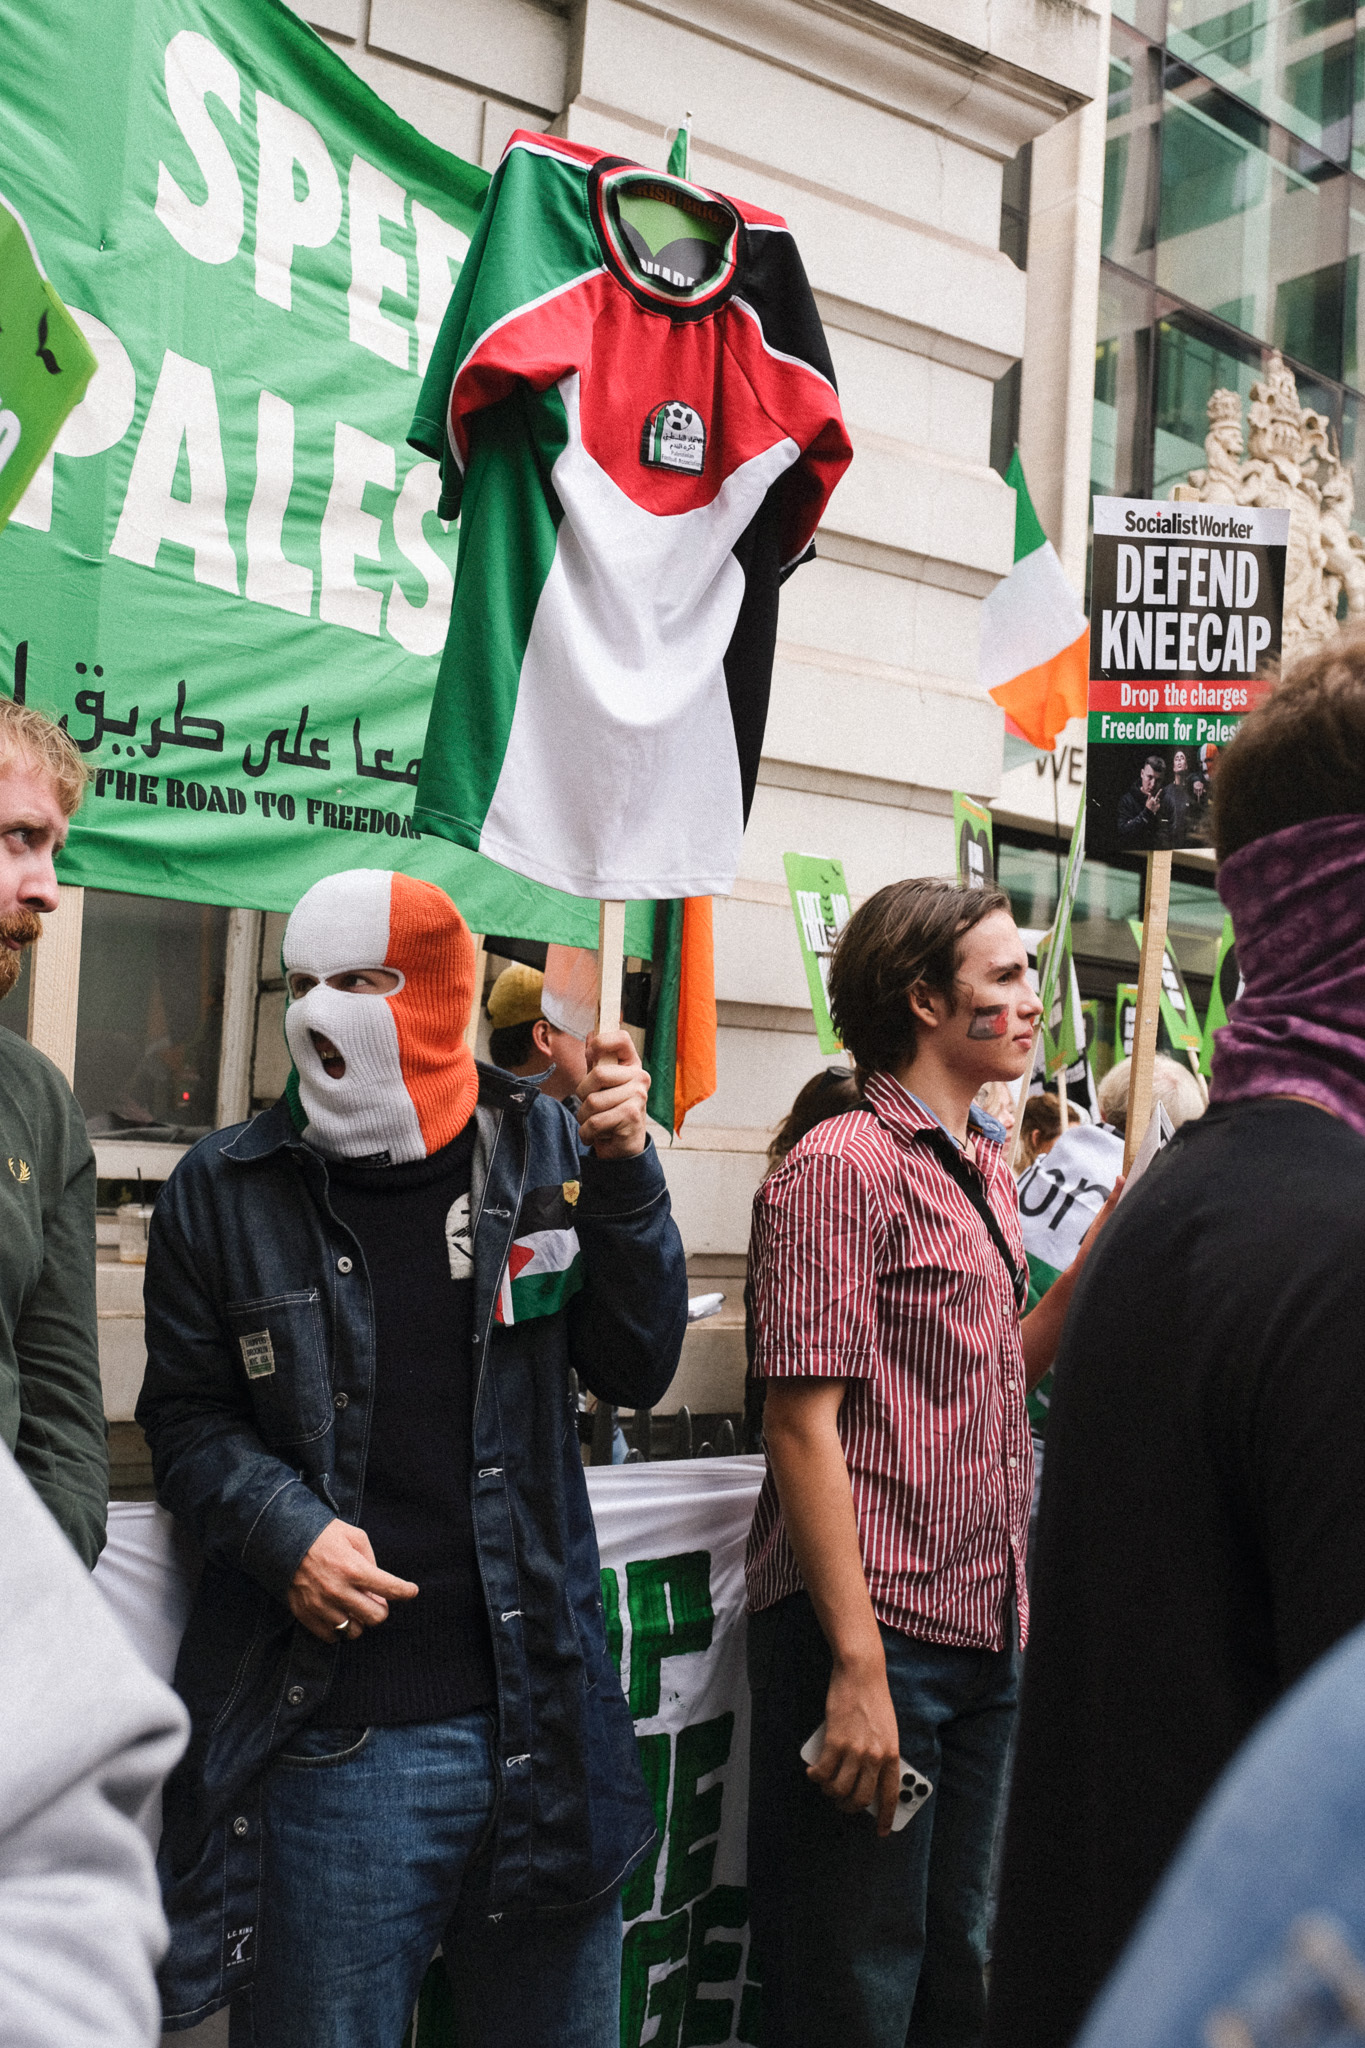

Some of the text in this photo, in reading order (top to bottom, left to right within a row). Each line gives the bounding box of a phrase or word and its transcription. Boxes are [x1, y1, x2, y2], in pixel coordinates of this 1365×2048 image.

[1116, 543, 1260, 609] DEFEND
[1101, 609, 1272, 673] KNEECAP
[57, 661, 225, 759] طريق
[1101, 715, 1169, 740] Freedom
[1173, 717, 1192, 741] for
[1120, 683, 1248, 711] Drop the charges
[242, 704, 331, 778] على
[88, 767, 422, 841] THE ROAD TO FREEDOM
